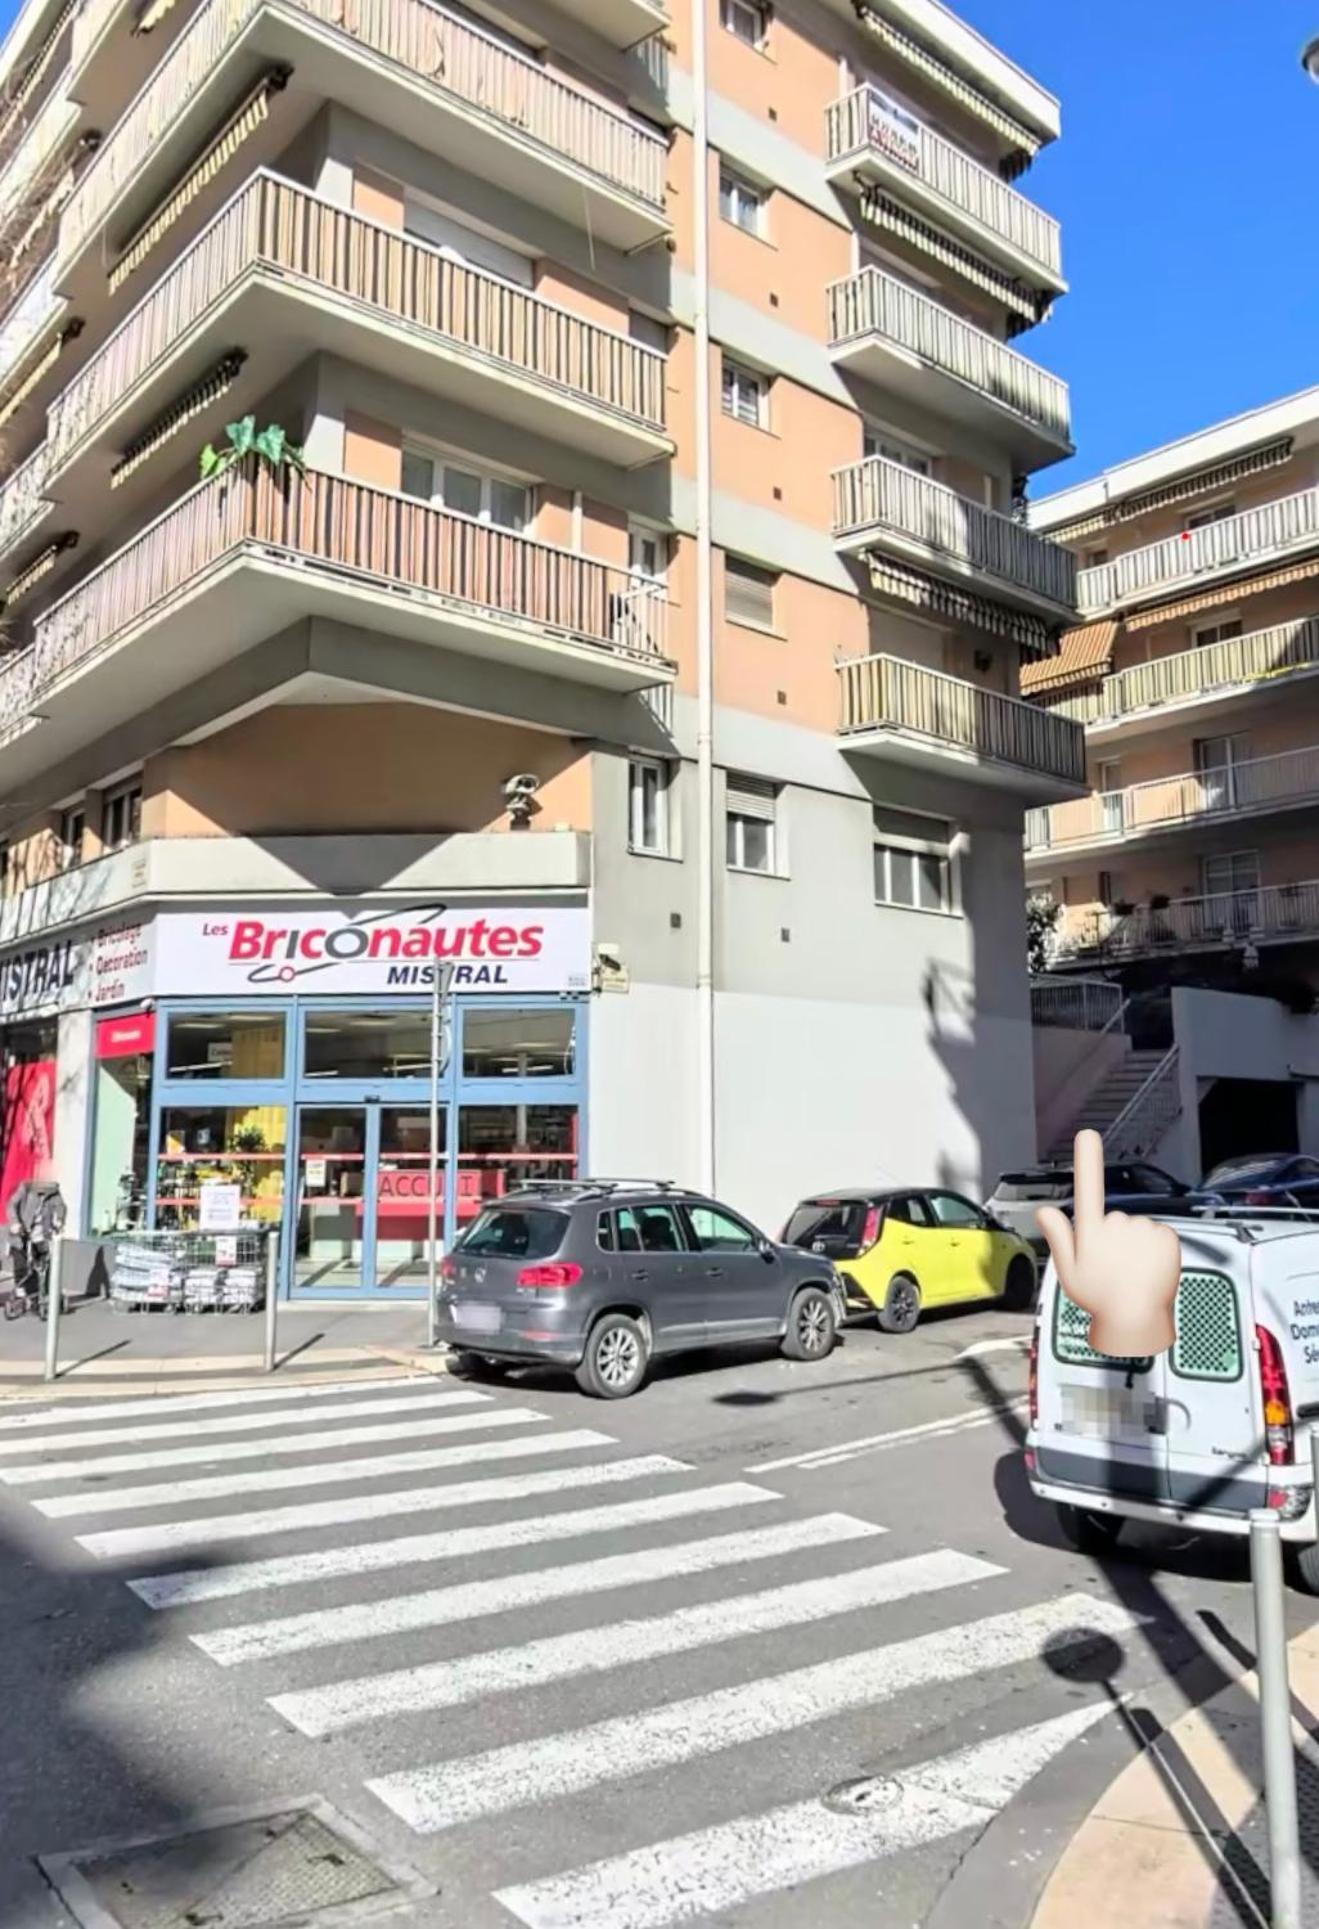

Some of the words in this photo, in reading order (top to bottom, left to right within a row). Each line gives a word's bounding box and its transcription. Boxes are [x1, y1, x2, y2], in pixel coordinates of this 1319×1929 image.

[203, 924, 228, 936] Les
[229, 919, 544, 960] Briconautes
[0, 939, 74, 1001] ISTRAL
[387, 965, 508, 985] MISRAL
[95, 978, 125, 1002] Jardin
